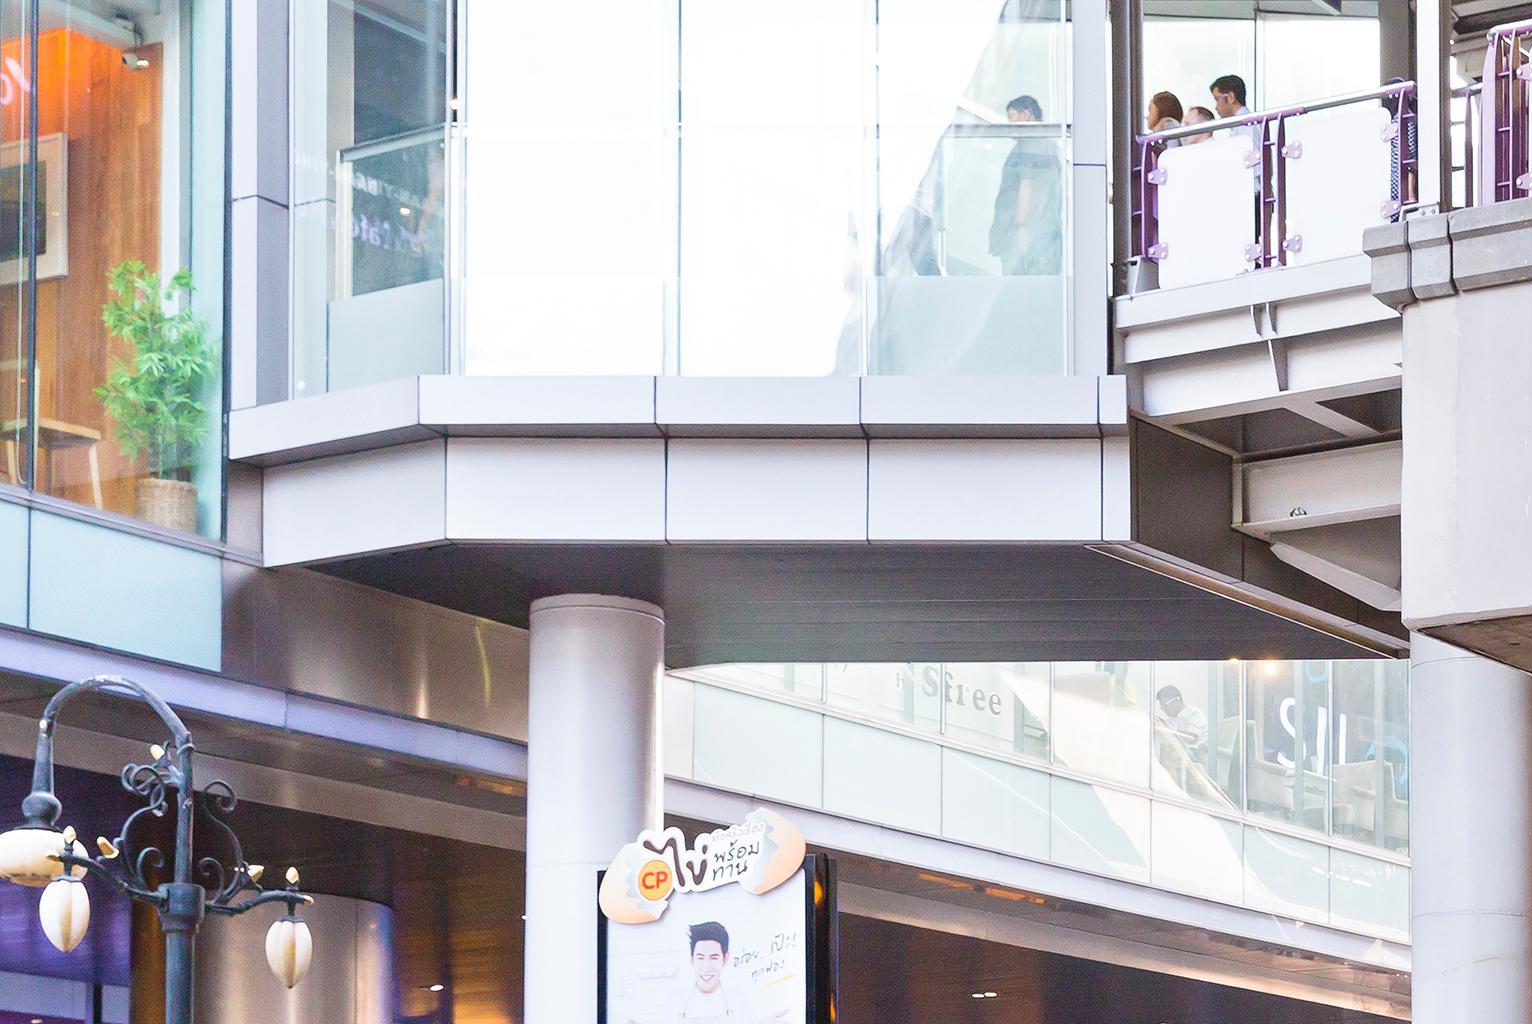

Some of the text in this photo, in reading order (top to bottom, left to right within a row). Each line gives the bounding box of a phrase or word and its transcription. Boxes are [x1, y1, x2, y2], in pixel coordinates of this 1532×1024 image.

[643, 837, 708, 888] ไข่
[713, 839, 761, 864] พร้อม
[641, 871, 668, 890] CP
[712, 859, 748, 882] ทาน
